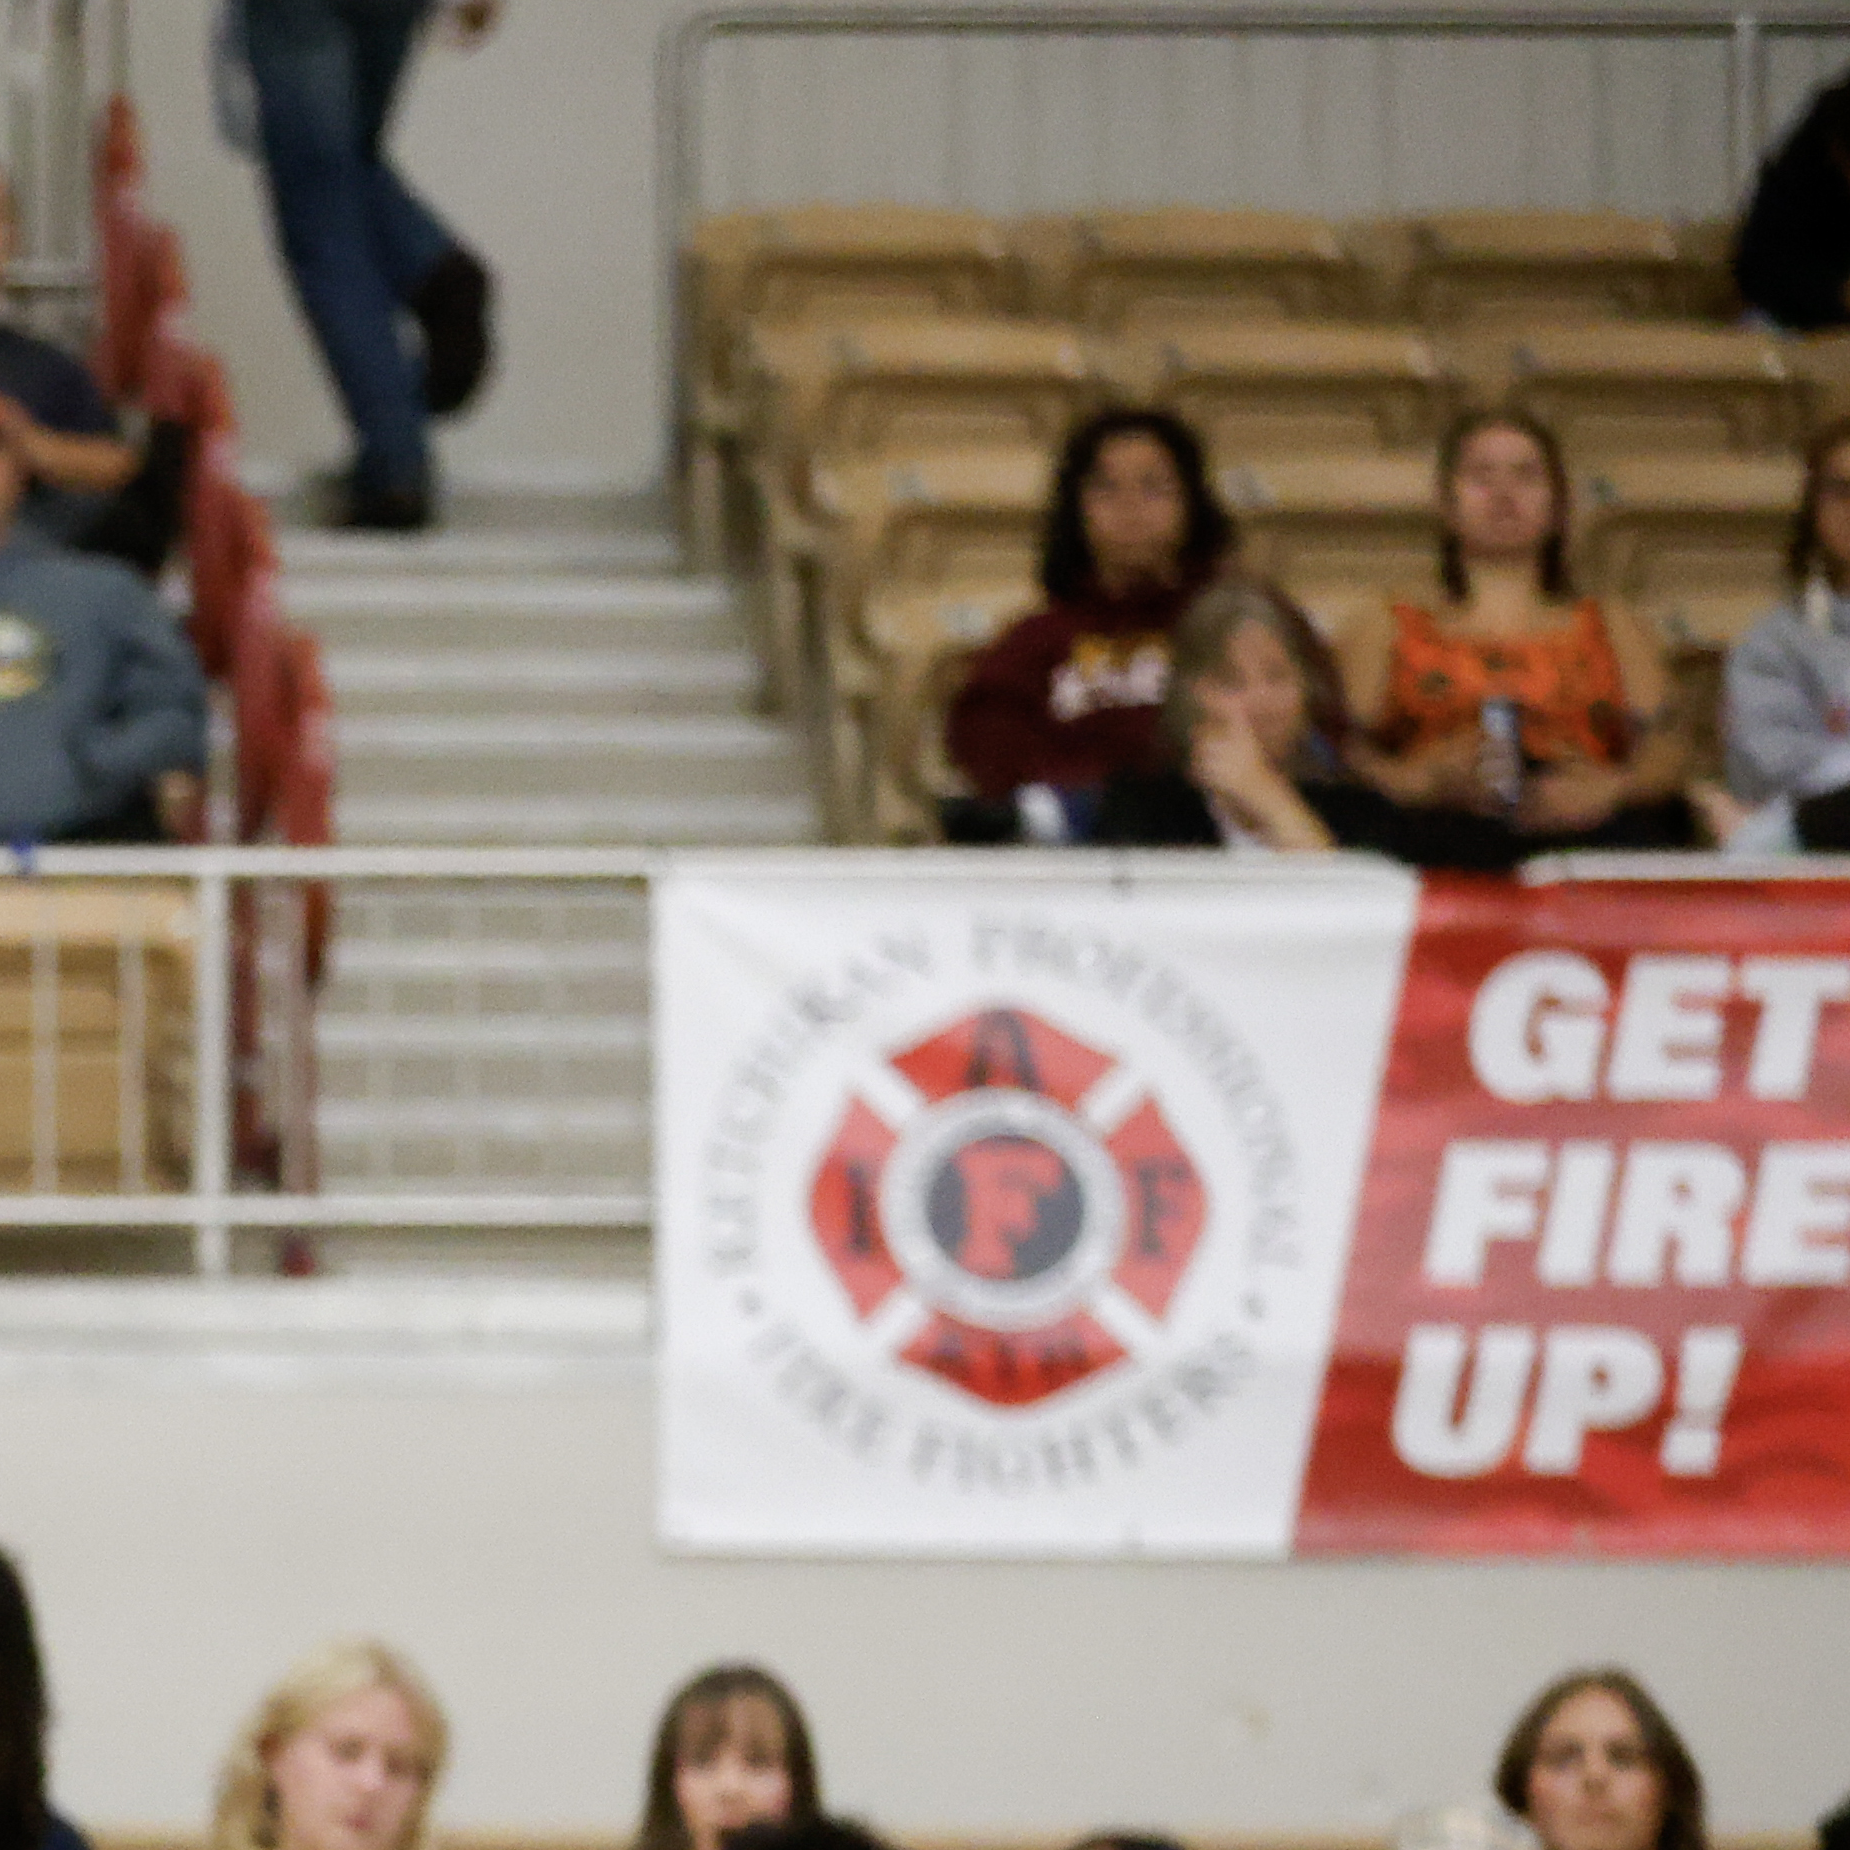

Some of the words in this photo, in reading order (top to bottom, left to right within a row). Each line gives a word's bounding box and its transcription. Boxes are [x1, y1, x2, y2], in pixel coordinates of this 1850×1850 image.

[1467, 948, 1850, 1104] GET
[1421, 1138, 1850, 1289] FIRE
[1390, 1322, 1744, 1480] UP!
